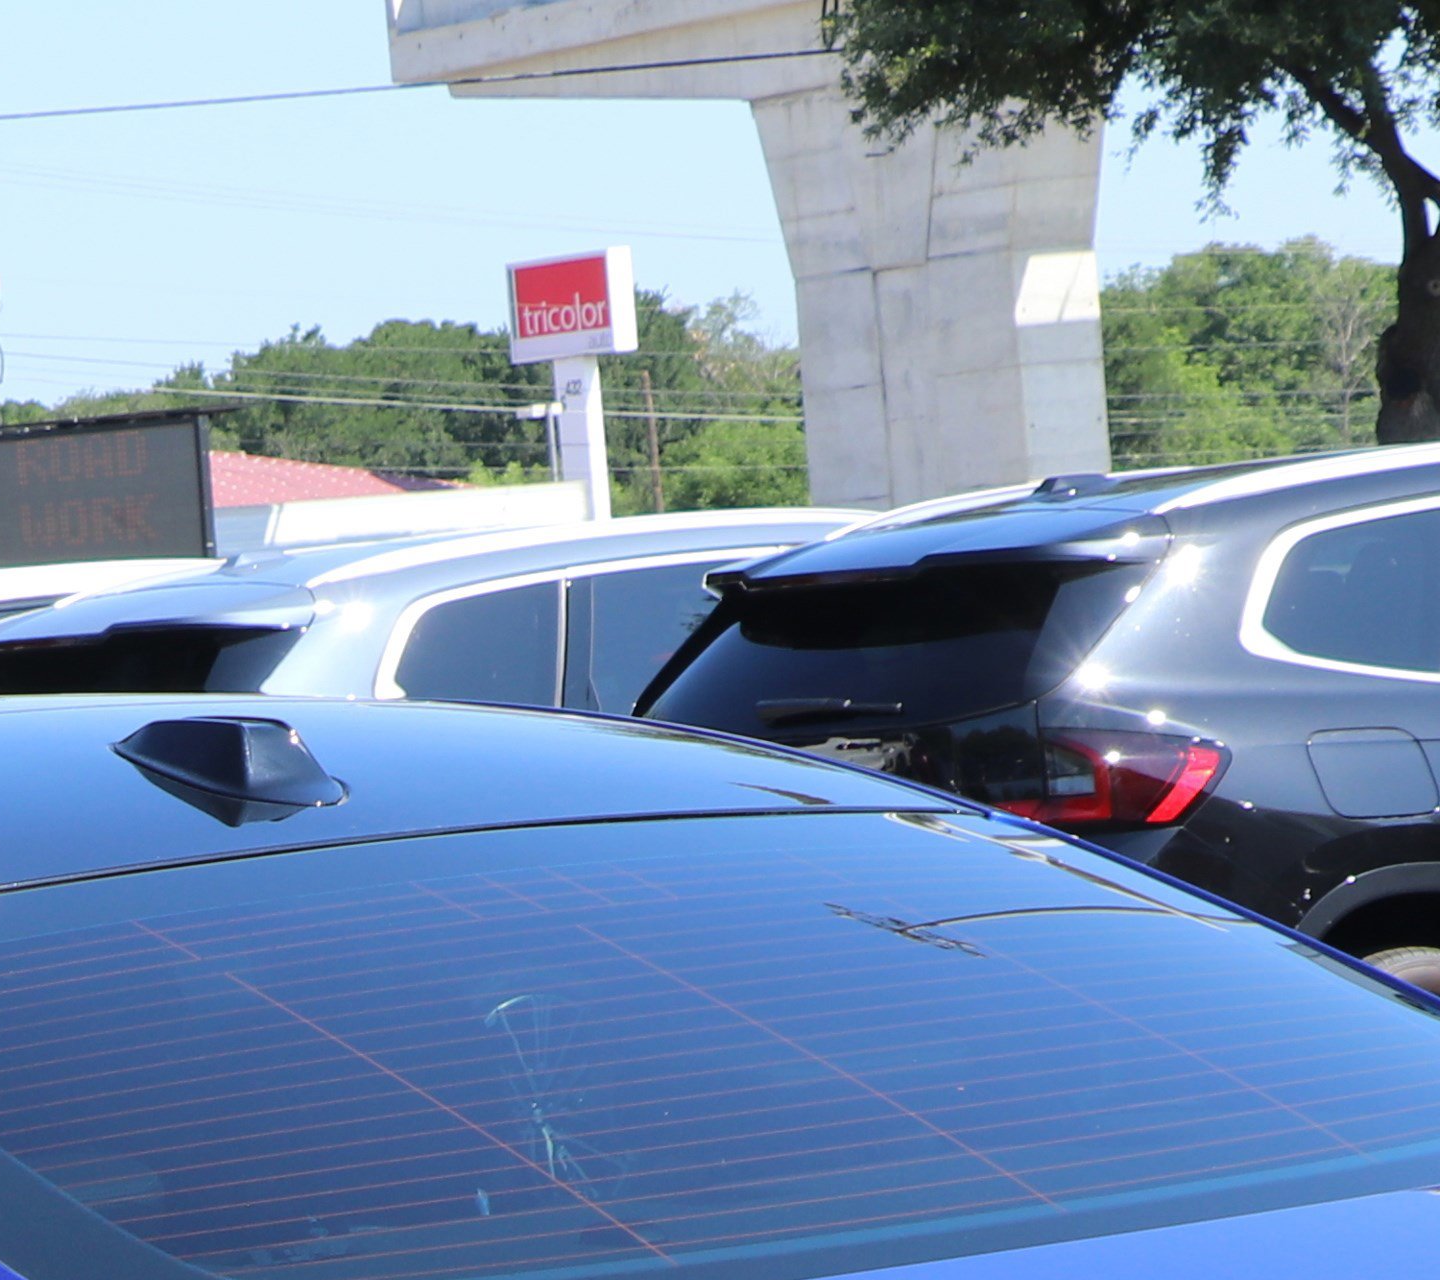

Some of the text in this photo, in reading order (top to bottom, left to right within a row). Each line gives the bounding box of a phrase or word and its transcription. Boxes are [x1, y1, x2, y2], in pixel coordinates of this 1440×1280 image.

[523, 292, 607, 335] tricolor
[16, 430, 148, 485] ROAD
[20, 494, 158, 546] WORK
